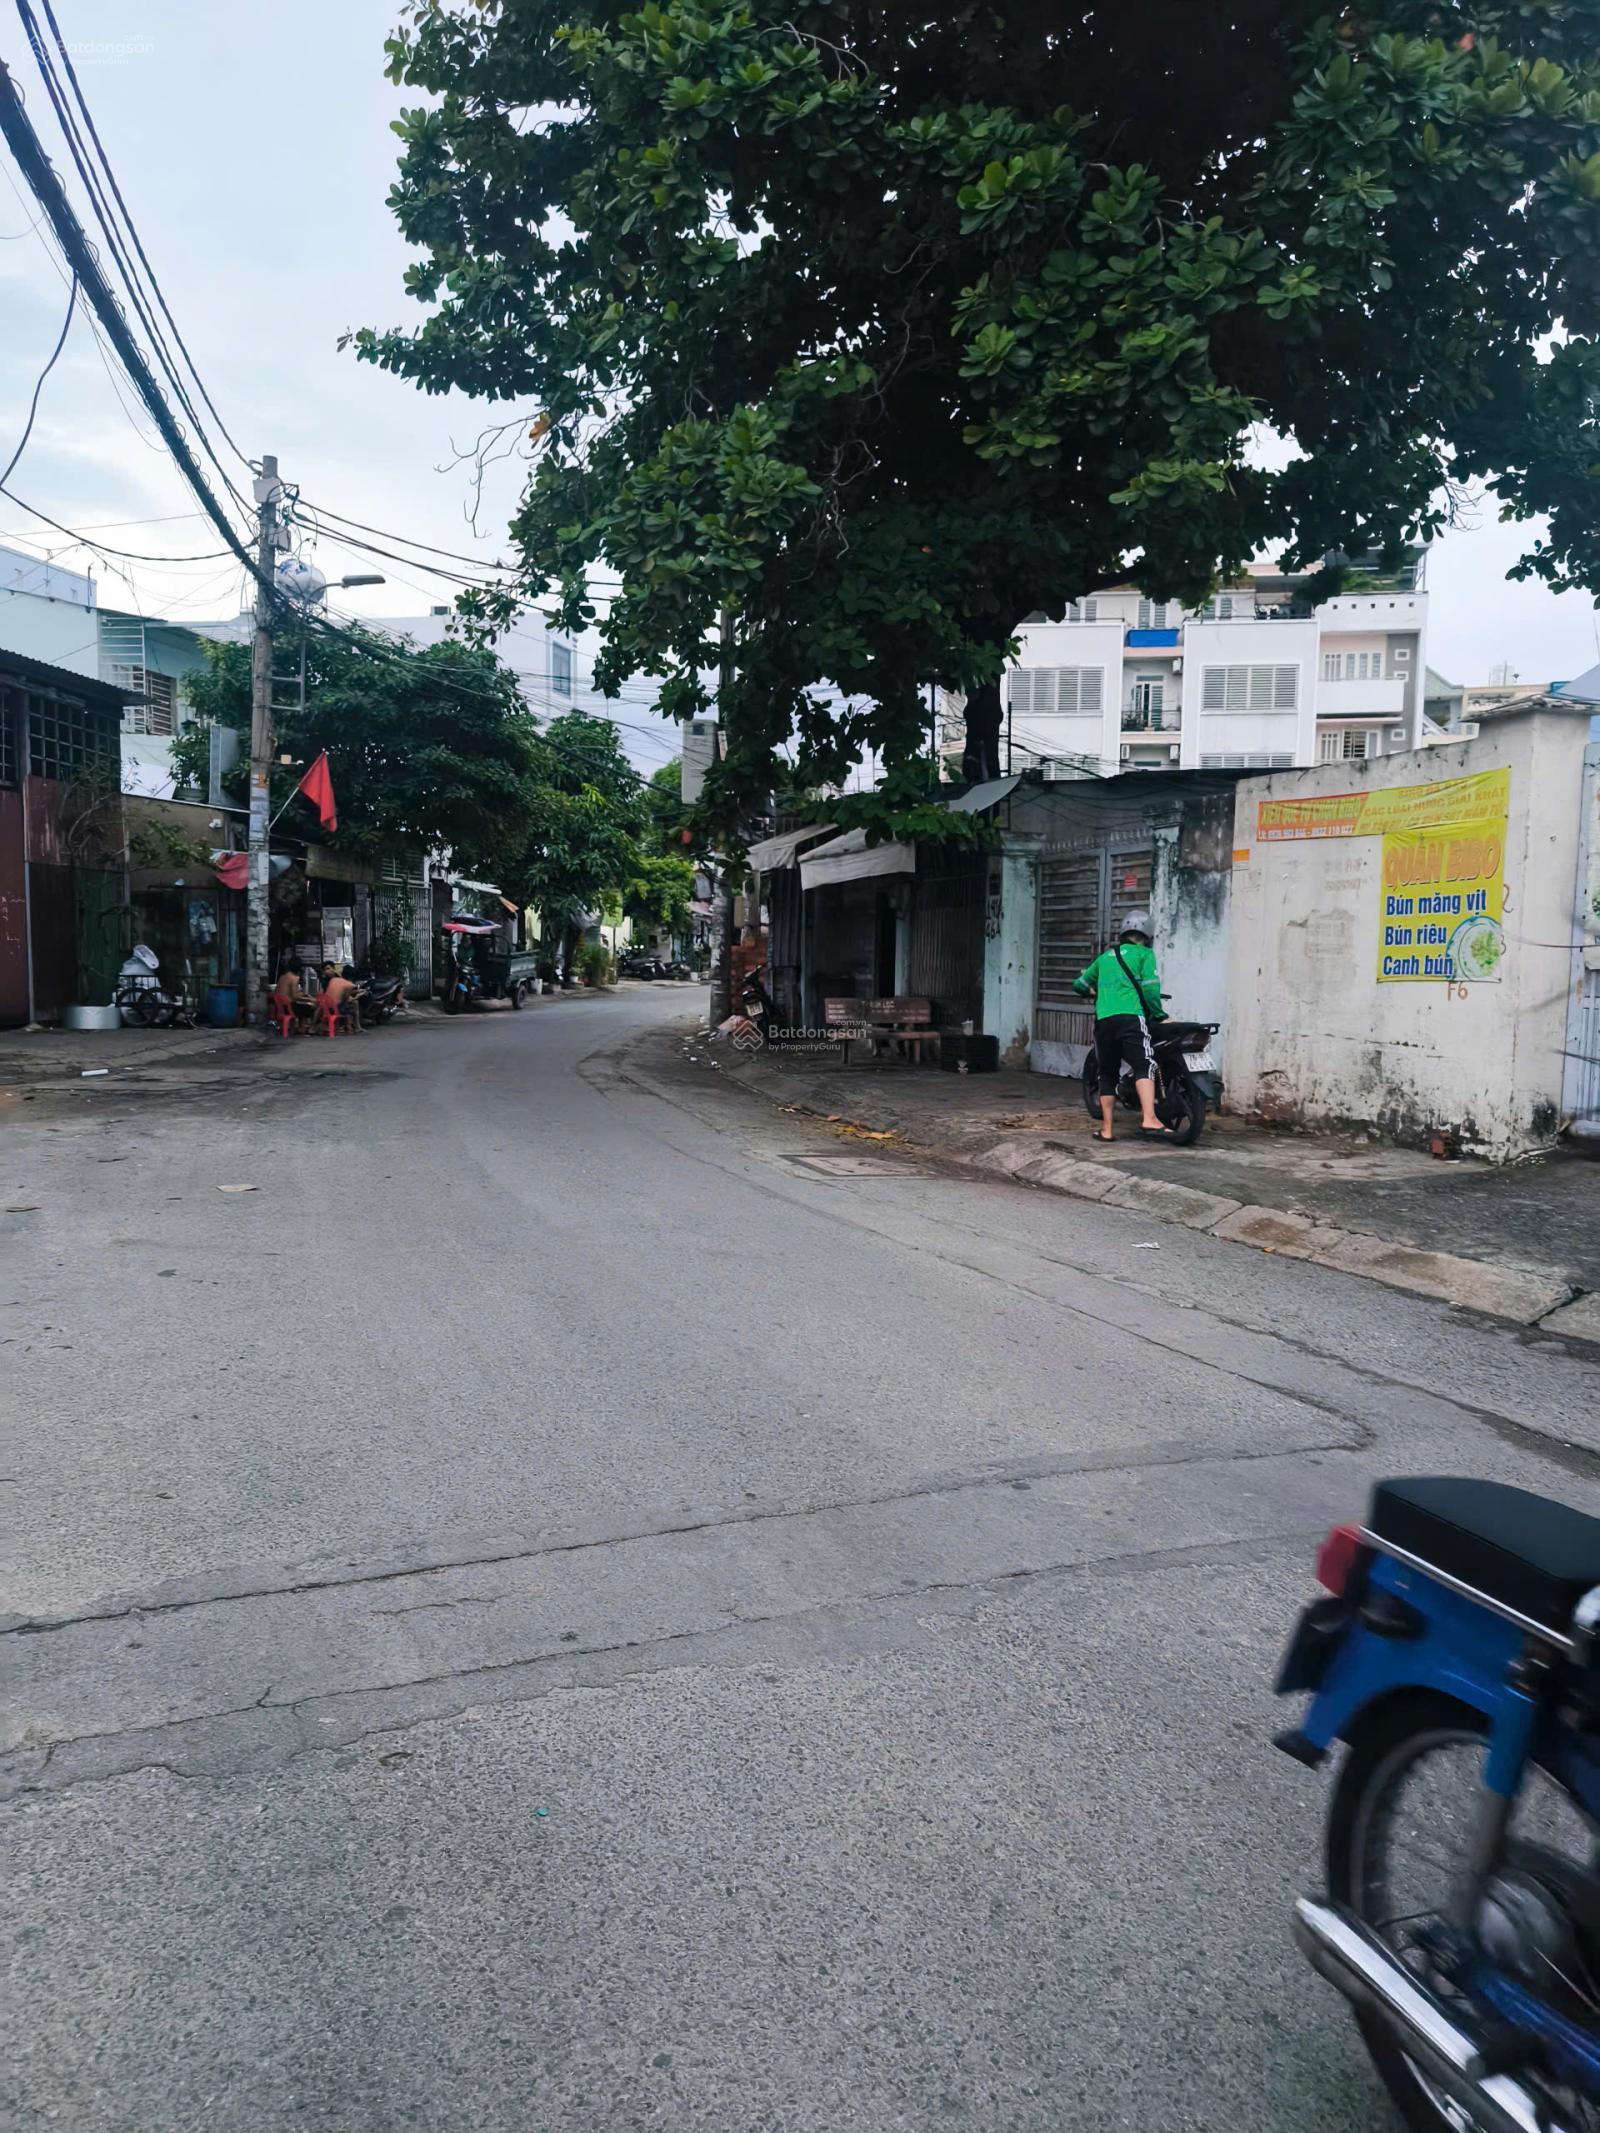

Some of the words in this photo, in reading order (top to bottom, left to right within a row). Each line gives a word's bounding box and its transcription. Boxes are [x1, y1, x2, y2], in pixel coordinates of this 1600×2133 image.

[1386, 894, 1413, 916] Bún
[1418, 892, 1461, 915] măng
[1466, 889, 1487, 917] vịt
[1385, 925, 1412, 946] Bún
[1416, 923, 1447, 945] riêu
[1383, 955, 1420, 976] Canh
[1424, 954, 1454, 976] bún
